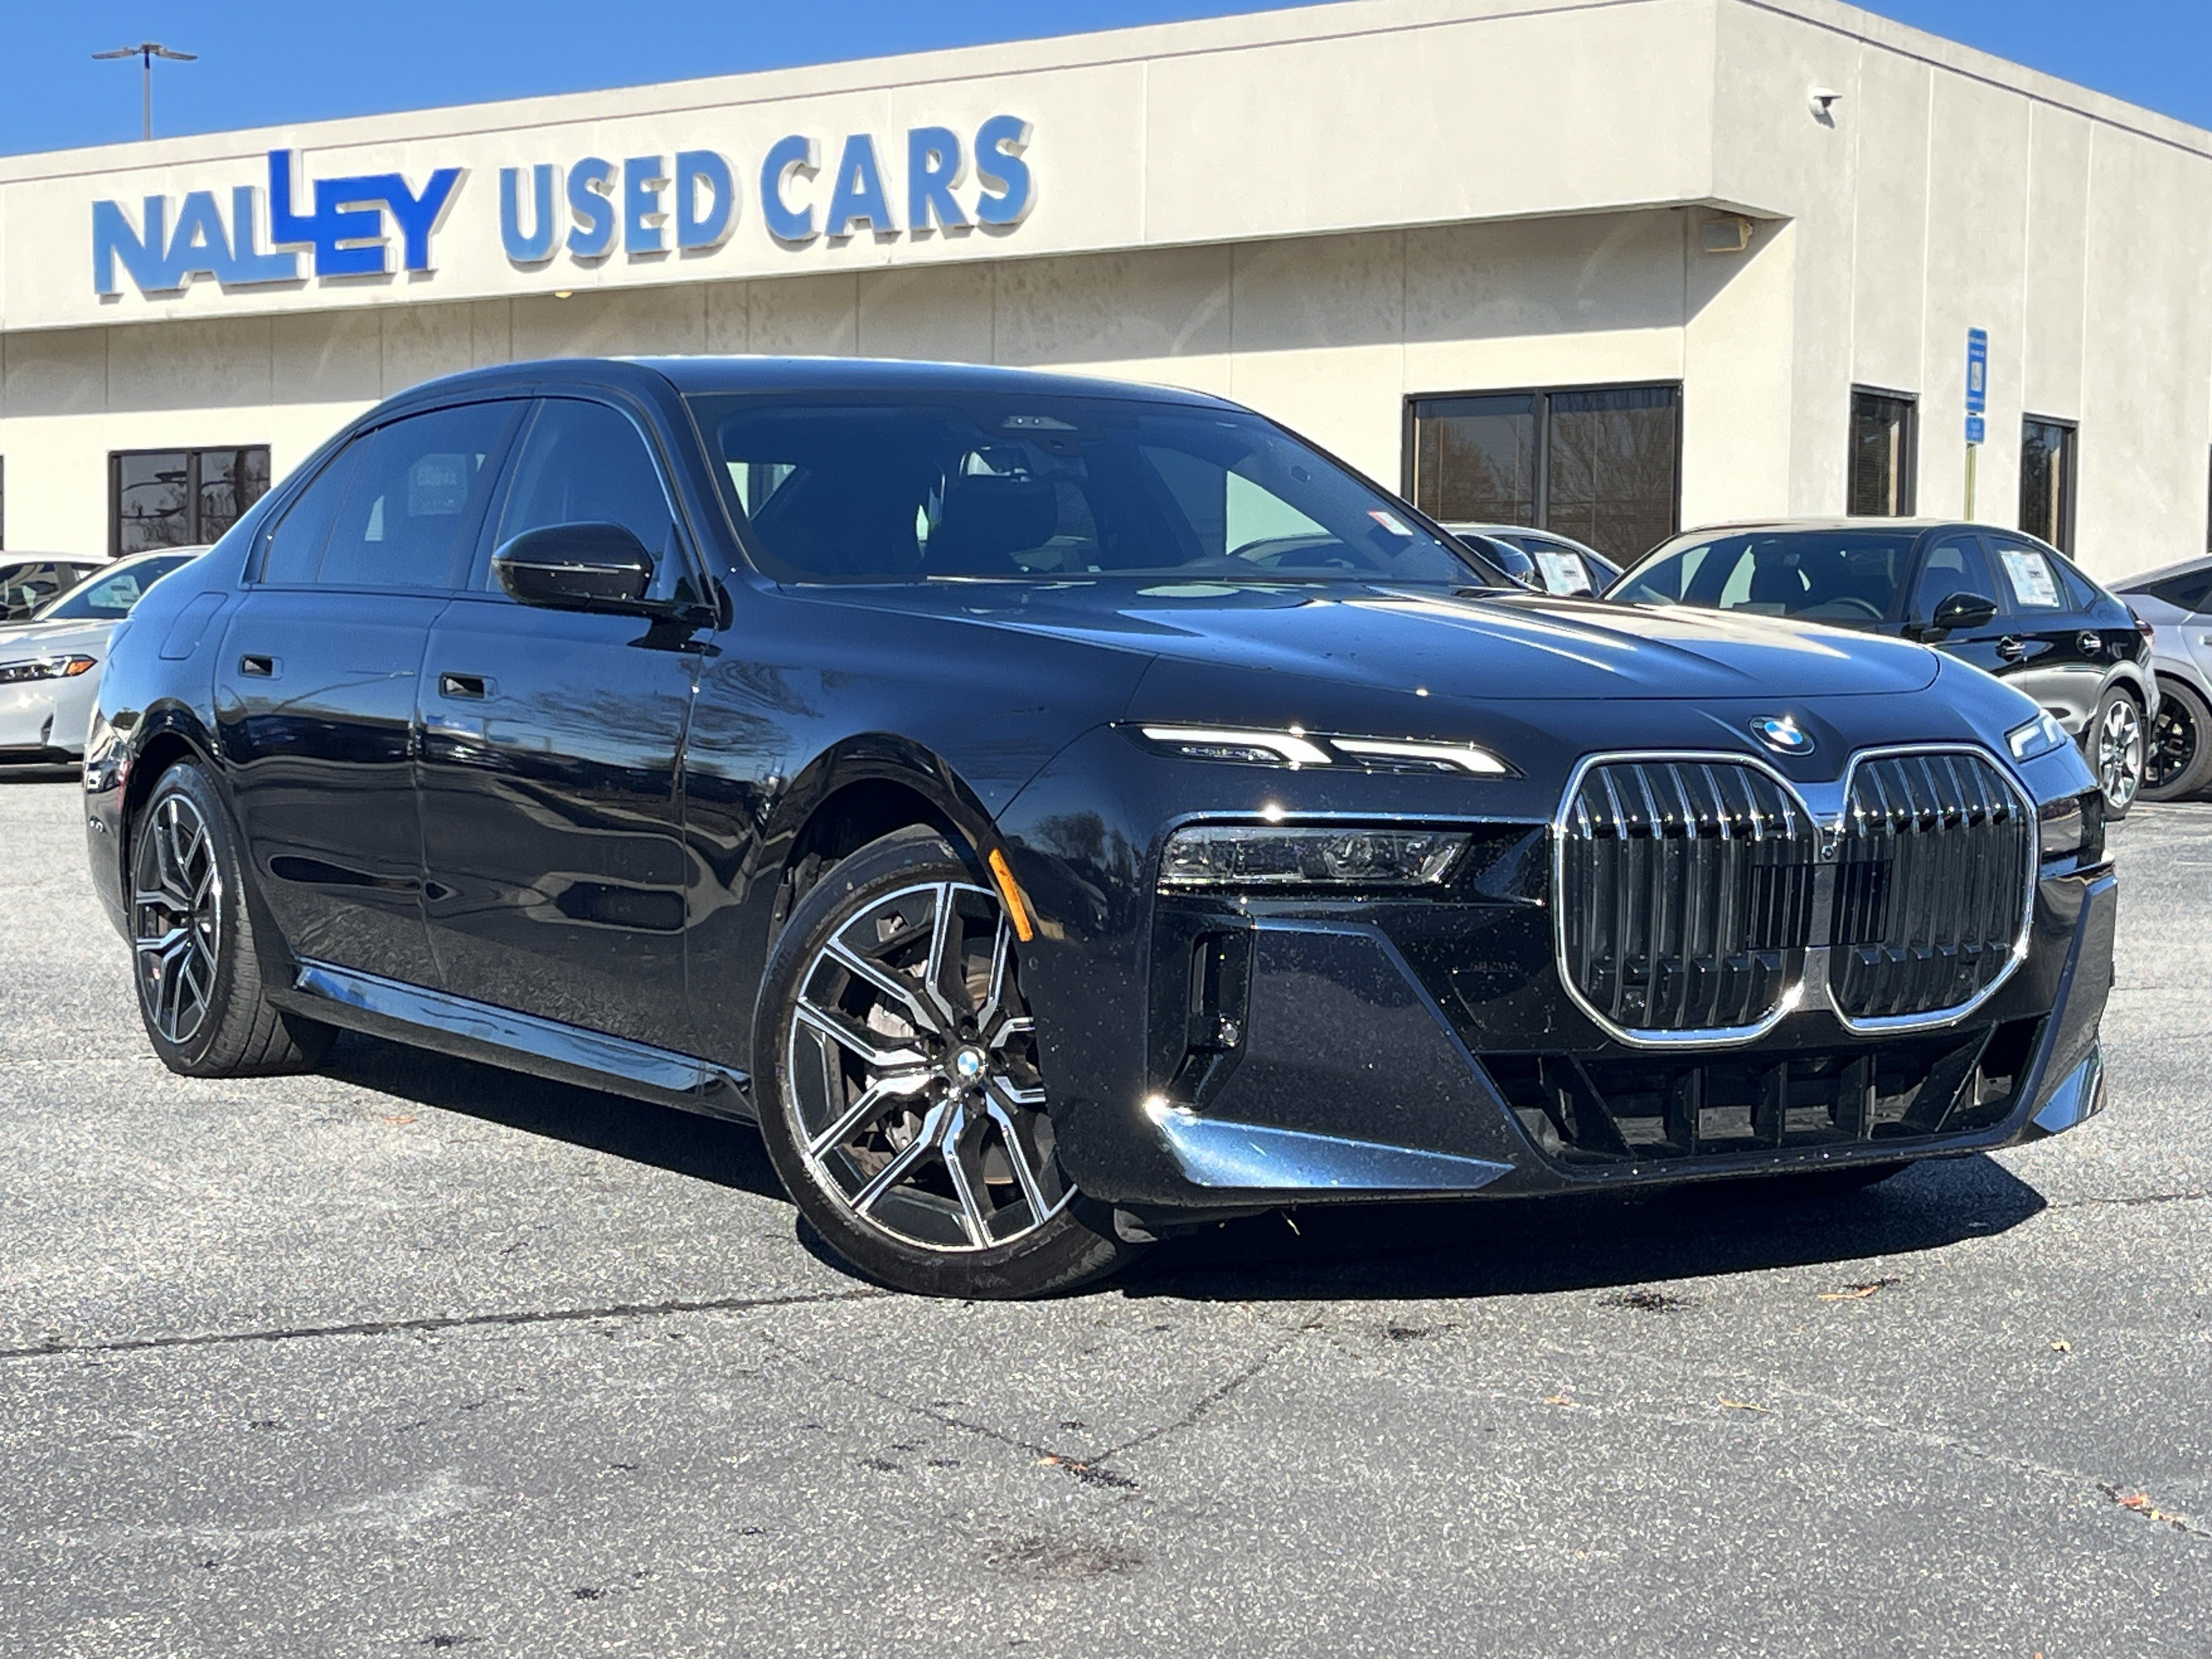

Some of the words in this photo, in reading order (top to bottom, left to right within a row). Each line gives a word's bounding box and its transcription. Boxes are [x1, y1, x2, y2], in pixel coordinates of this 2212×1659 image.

[92, 149, 465, 296] NALLEY
[500, 149, 733, 262] USED
[760, 114, 1030, 241] CARS
